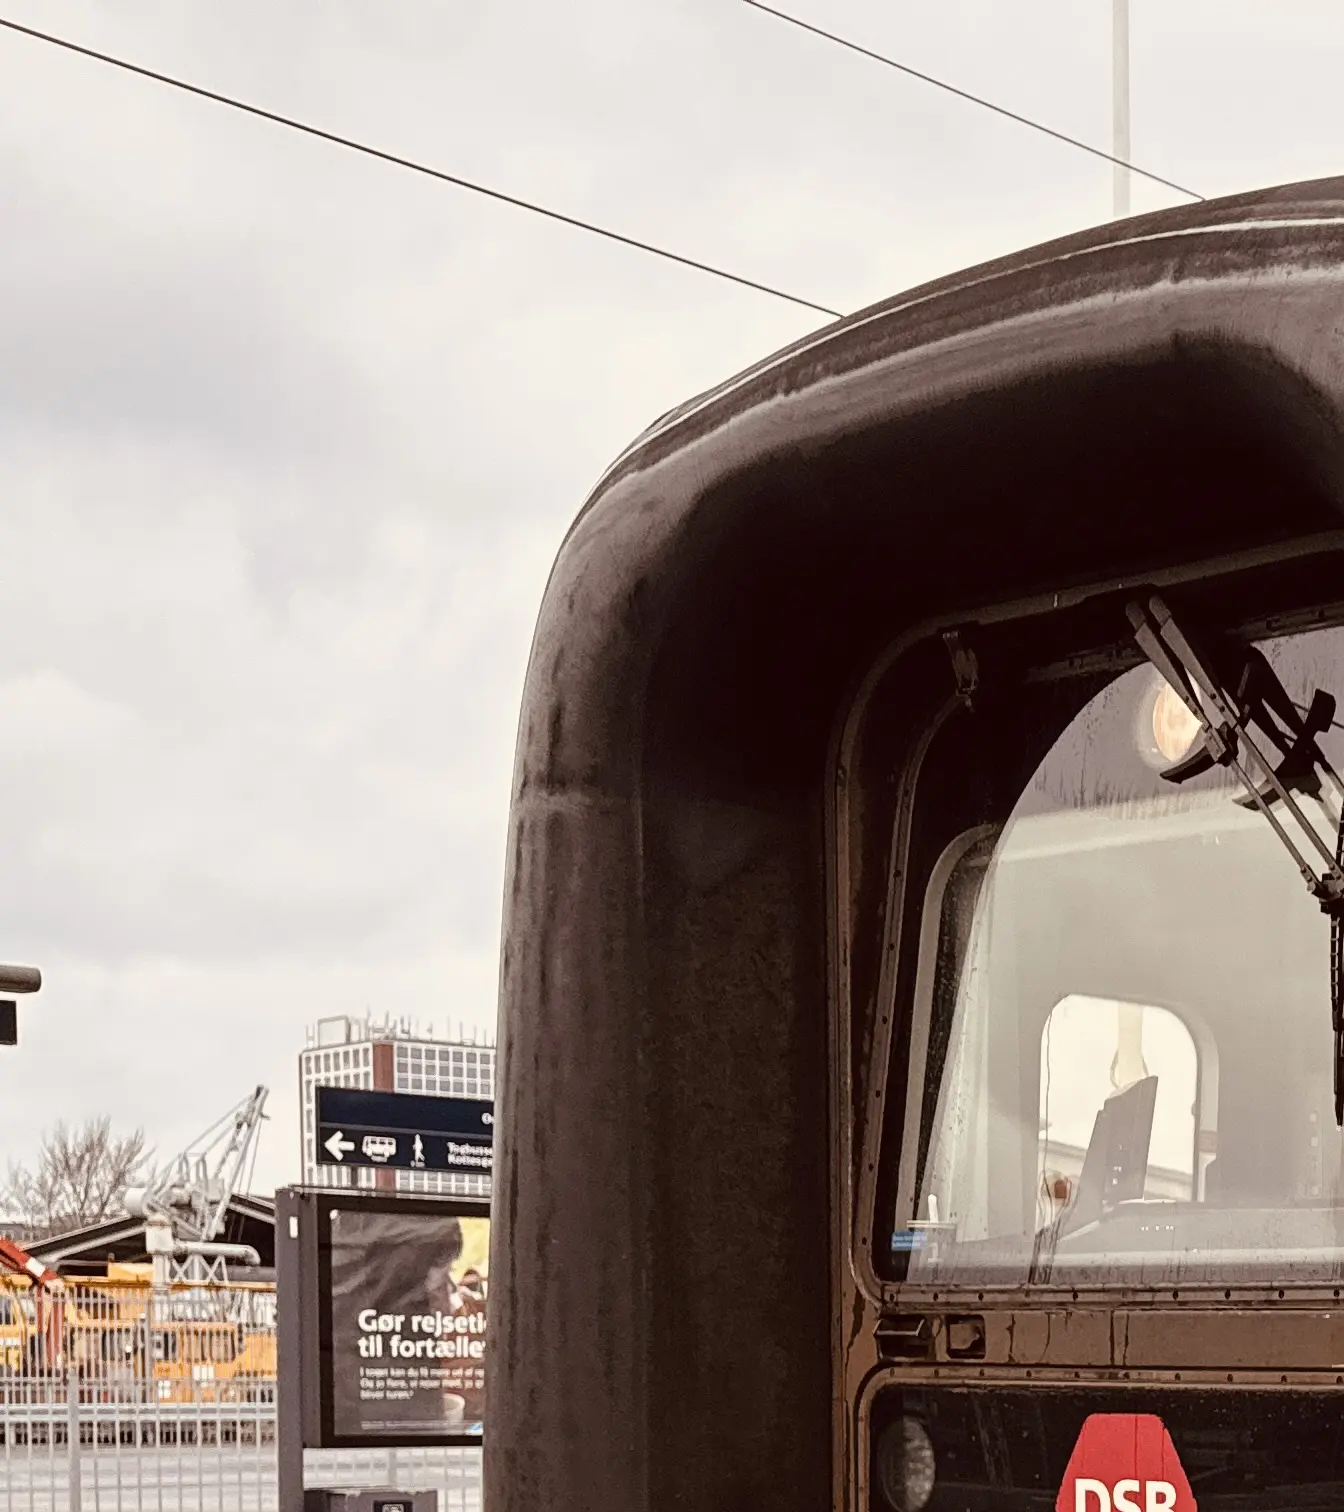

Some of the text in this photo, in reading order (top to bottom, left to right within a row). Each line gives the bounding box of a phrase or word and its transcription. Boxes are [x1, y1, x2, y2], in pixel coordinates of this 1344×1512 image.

[358, 1309, 487, 1338] Gør rejseti
[358, 1334, 383, 1358] til
